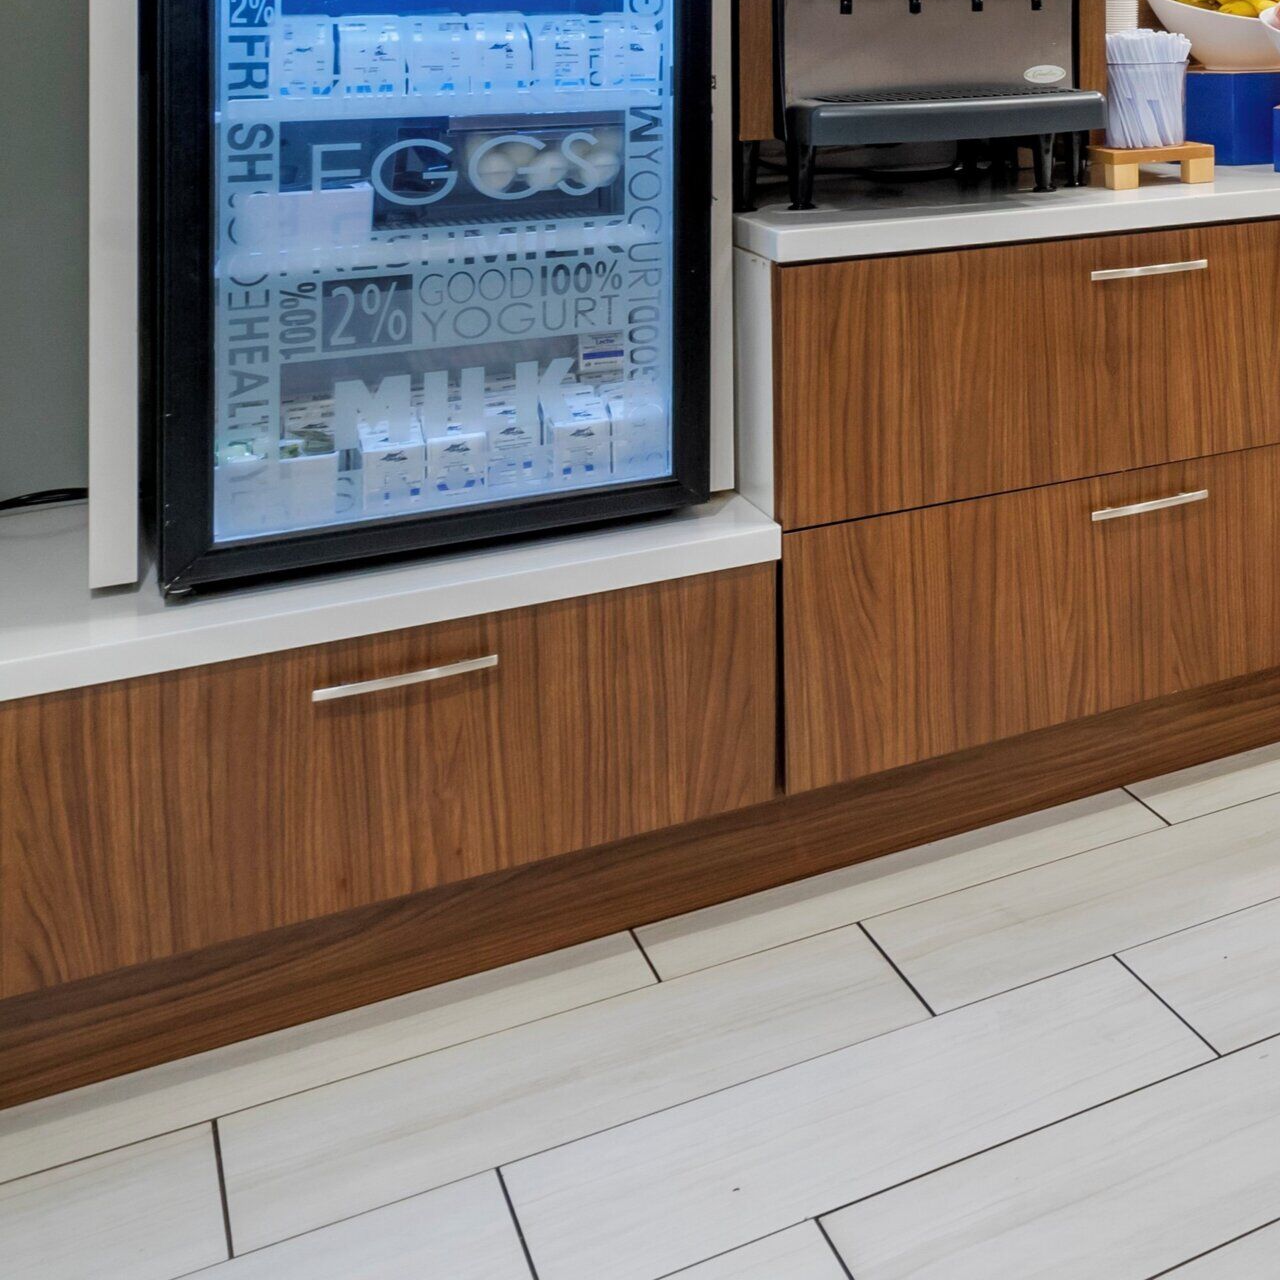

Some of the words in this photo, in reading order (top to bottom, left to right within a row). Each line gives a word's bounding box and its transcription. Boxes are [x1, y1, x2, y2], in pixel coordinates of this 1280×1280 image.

[228, 35, 274, 183] FRSH
[312, 132, 600, 206] EGGS
[330, 281, 408, 347] 2%
[418, 266, 535, 306] GOOD
[541, 260, 622, 297] 100%
[422, 294, 621, 342] YOGURT
[279, 281, 318, 362] 100%
[228, 315, 271, 485] HEALTY
